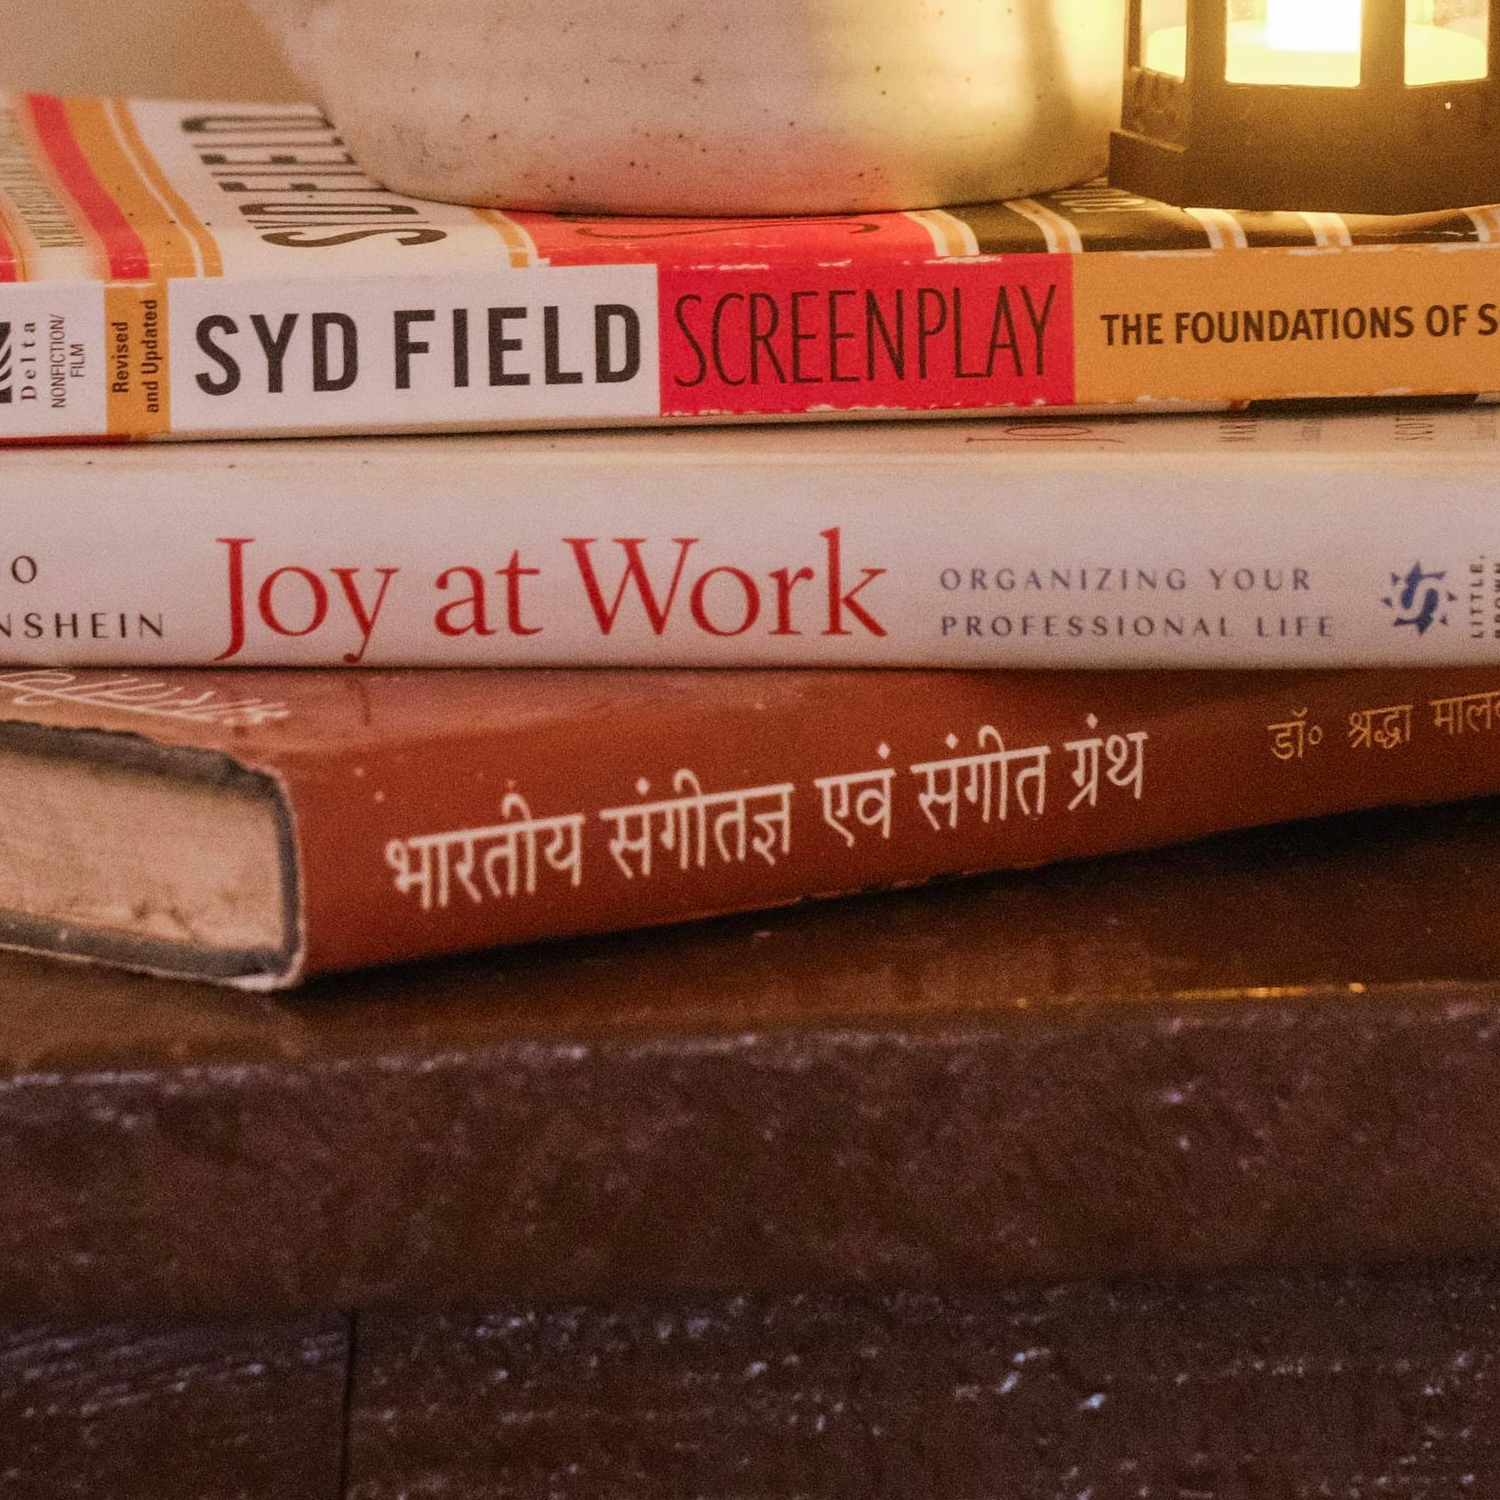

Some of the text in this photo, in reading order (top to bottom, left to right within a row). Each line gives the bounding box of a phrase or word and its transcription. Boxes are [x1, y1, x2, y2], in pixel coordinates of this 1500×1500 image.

[21, 322, 37, 401] Delta
[70, 343, 85, 378] FILM
[112, 321, 130, 393] Revised
[140, 299, 162, 414] and Updated
[194, 303, 641, 397] SYD FIELD
[674, 283, 1057, 388] SCREENPLAY
[1100, 312, 1164, 346] THE
[1174, 305, 1415, 344] FOUNDATIONS
[1425, 304, 1469, 337] OF
[213, 525, 889, 664] Joy at Work
[939, 567, 1312, 592] ORGANIZING YOUR
[940, 614, 1335, 638] PROFESSIONAL LIFE
[1347, 703, 1414, 750] श्रद्धा
[385, 712, 1149, 910] भारतीय संगीतज्ञ एवं संगीत ग्रंथ
